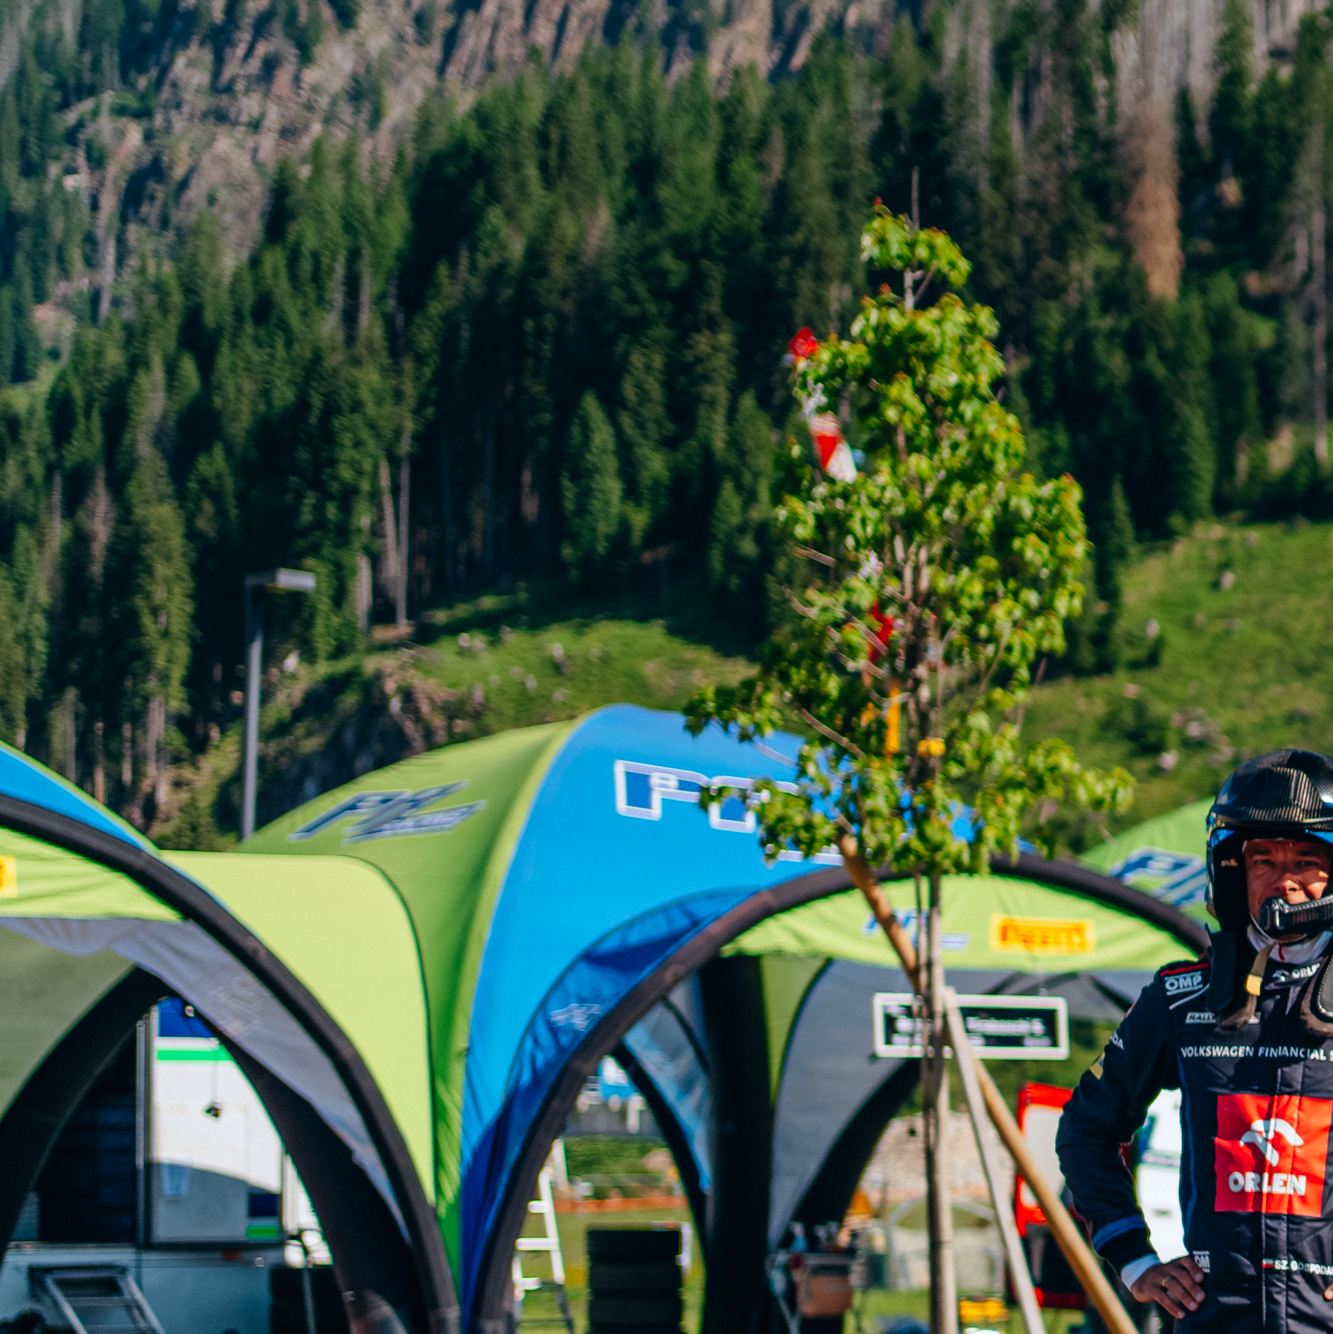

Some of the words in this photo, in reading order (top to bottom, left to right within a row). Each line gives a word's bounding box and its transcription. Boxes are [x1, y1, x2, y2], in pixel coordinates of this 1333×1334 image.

[1165, 975, 1202, 991] OMP
[1181, 1046, 1254, 1058] VOLKSWAGEN
[1228, 1171, 1307, 1196] ORLEN
